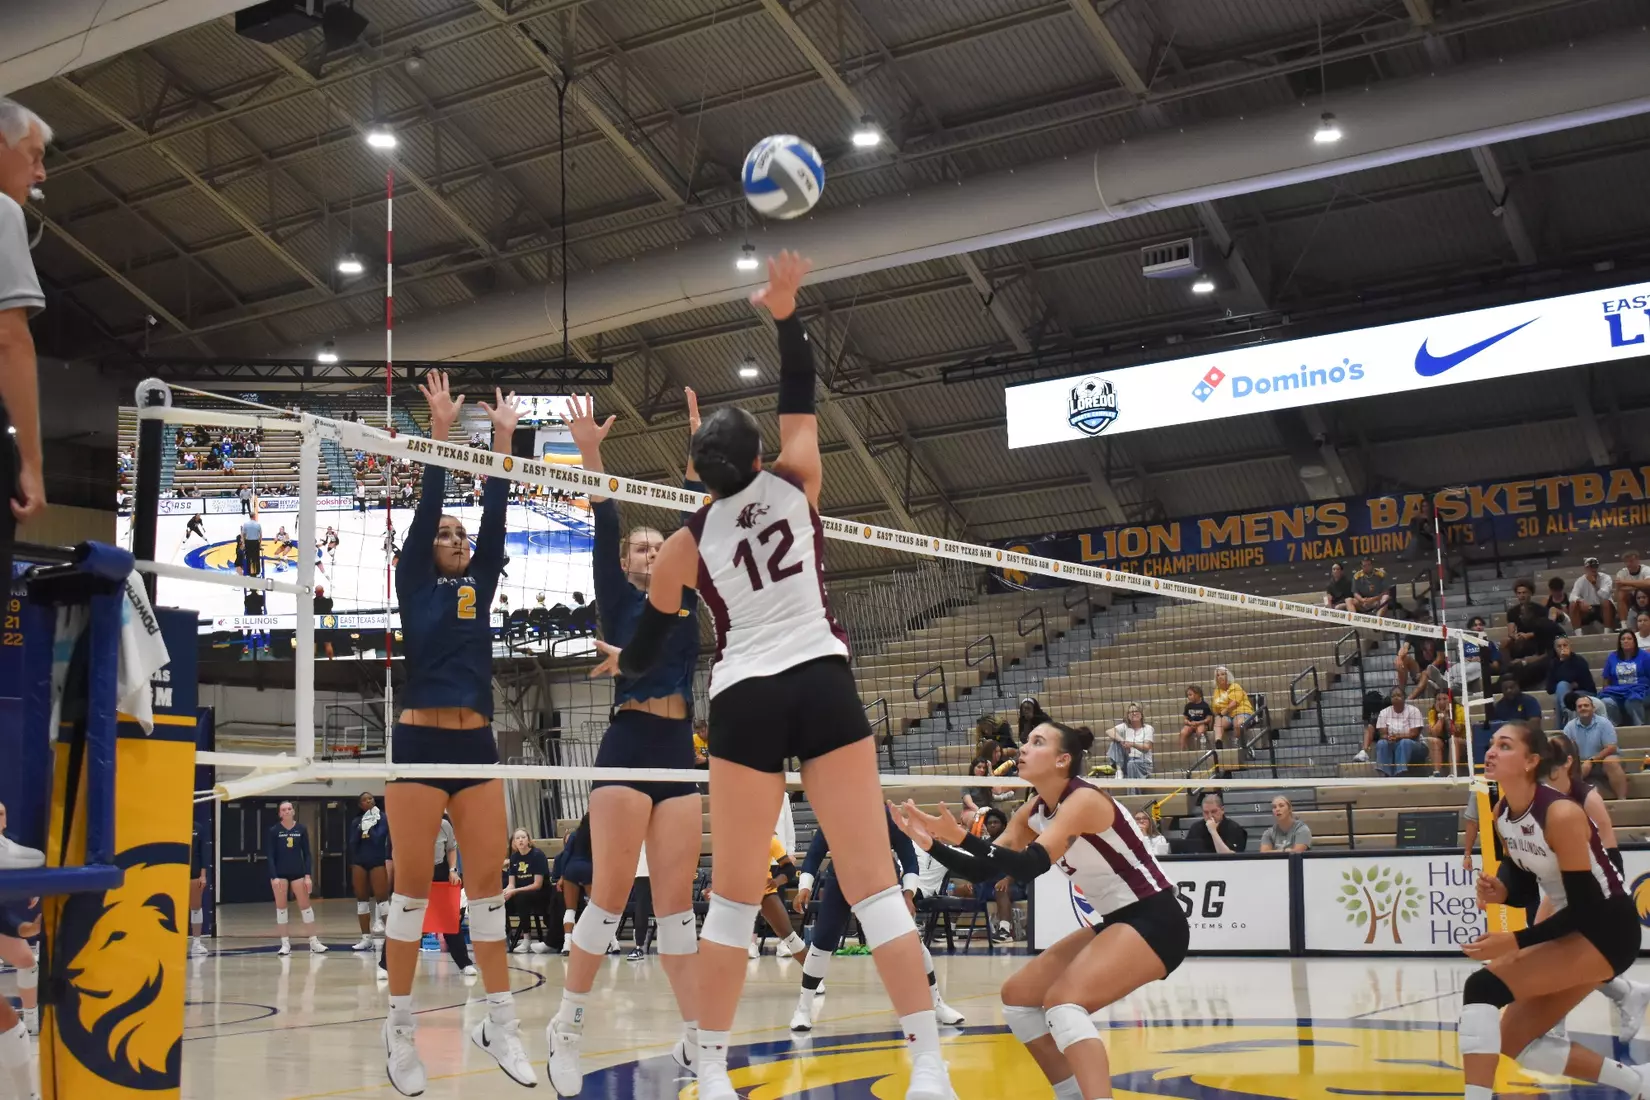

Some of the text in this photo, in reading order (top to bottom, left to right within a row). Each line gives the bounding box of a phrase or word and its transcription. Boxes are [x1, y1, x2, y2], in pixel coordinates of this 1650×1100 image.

[1602, 294, 1650, 313] EAS
[1232, 358, 1364, 398] Domino's
[1068, 394, 1116, 414] LOREDO
[406, 439, 494, 467] EAST TEXAS A&M
[522, 464, 600, 488] EAST TEXAS A&M
[626, 483, 696, 505] EAST TEXAS A&M
[822, 520, 858, 535] TEXAS A&M
[876, 531, 928, 548] EAST TEXAS A&M
[1078, 522, 1181, 562] LION
[1198, 502, 1349, 550] MEN'S
[732, 518, 804, 592] 12
[944, 543, 959, 553] EAST
[960, 546, 978, 556] TEXAS
[1144, 546, 1264, 577] CHAMPIONSHIPS
[1287, 542, 1296, 562] 7
[1302, 538, 1344, 560] NCAA
[1350, 524, 1474, 556] TOURNATS
[1517, 516, 1539, 538] 30
[458, 586, 476, 620] 2
[4, 615, 20, 629] 21
[242, 617, 278, 625] ILLINOIS
[340, 616, 355, 624] EAST
[357, 616, 376, 624] TEXAS
[4, 632, 24, 646] 22
[1429, 862, 1481, 886] Hun
[1176, 880, 1226, 918] SG
[1430, 890, 1482, 924] Reg
[1431, 918, 1488, 944] Heal
